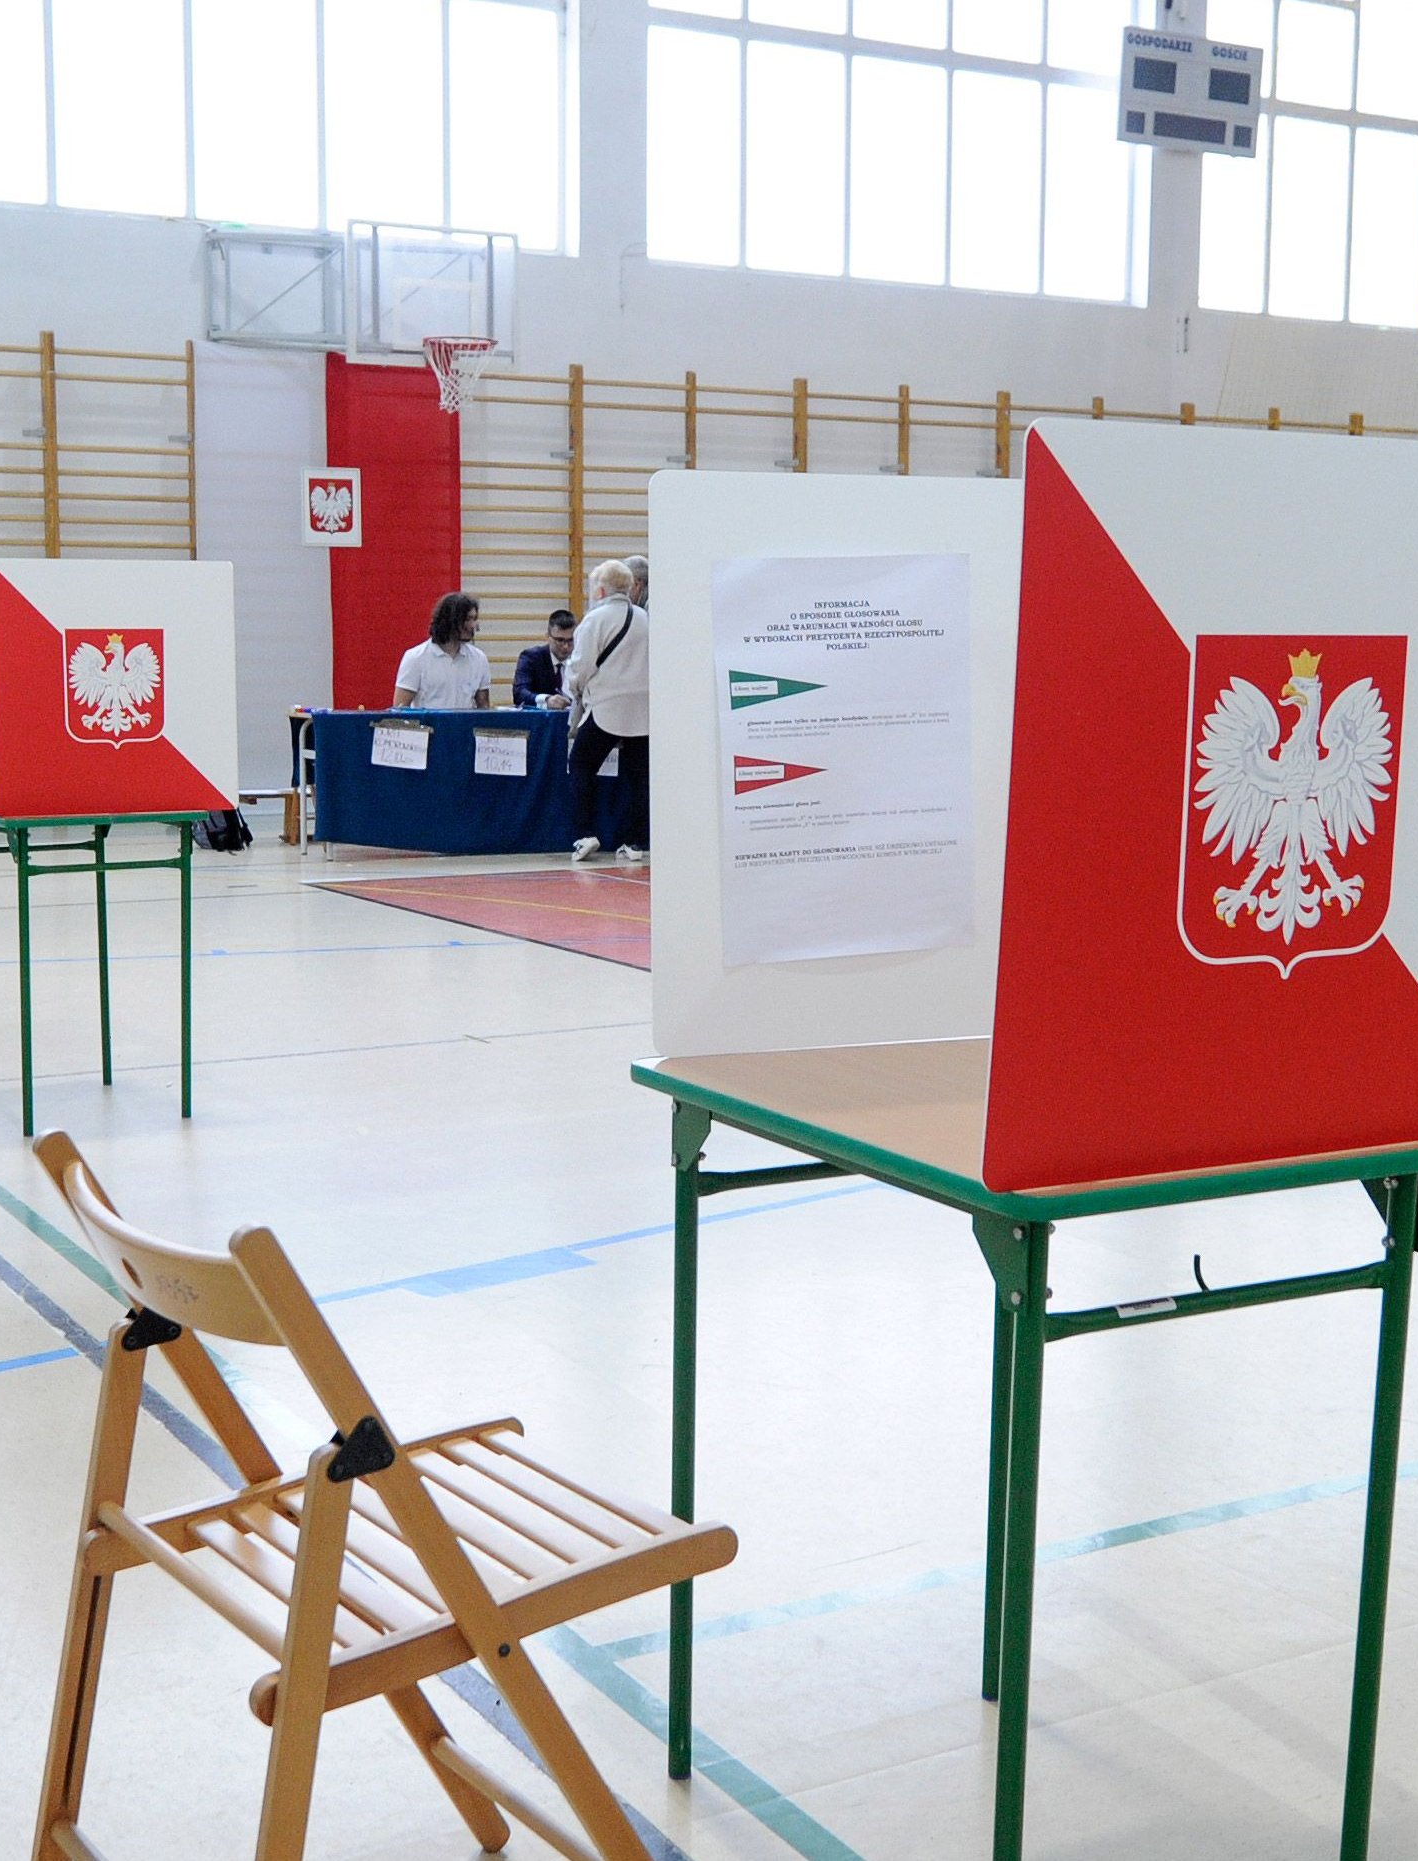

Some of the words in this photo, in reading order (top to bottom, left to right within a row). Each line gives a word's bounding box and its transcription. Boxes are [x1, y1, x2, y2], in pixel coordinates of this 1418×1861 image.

[814, 600, 870, 609] INFORMACJA
[790, 612, 797, 620] O
[799, 611, 842, 620] SPOSOBIE
[766, 624, 790, 632] ORAZ
[792, 621, 848, 631] WARUNKACH
[753, 634, 803, 643] WYBORACH
[806, 632, 862, 641] PREZYDENTA
[864, 630, 945, 639] RZECZYPOSPOLITEJ
